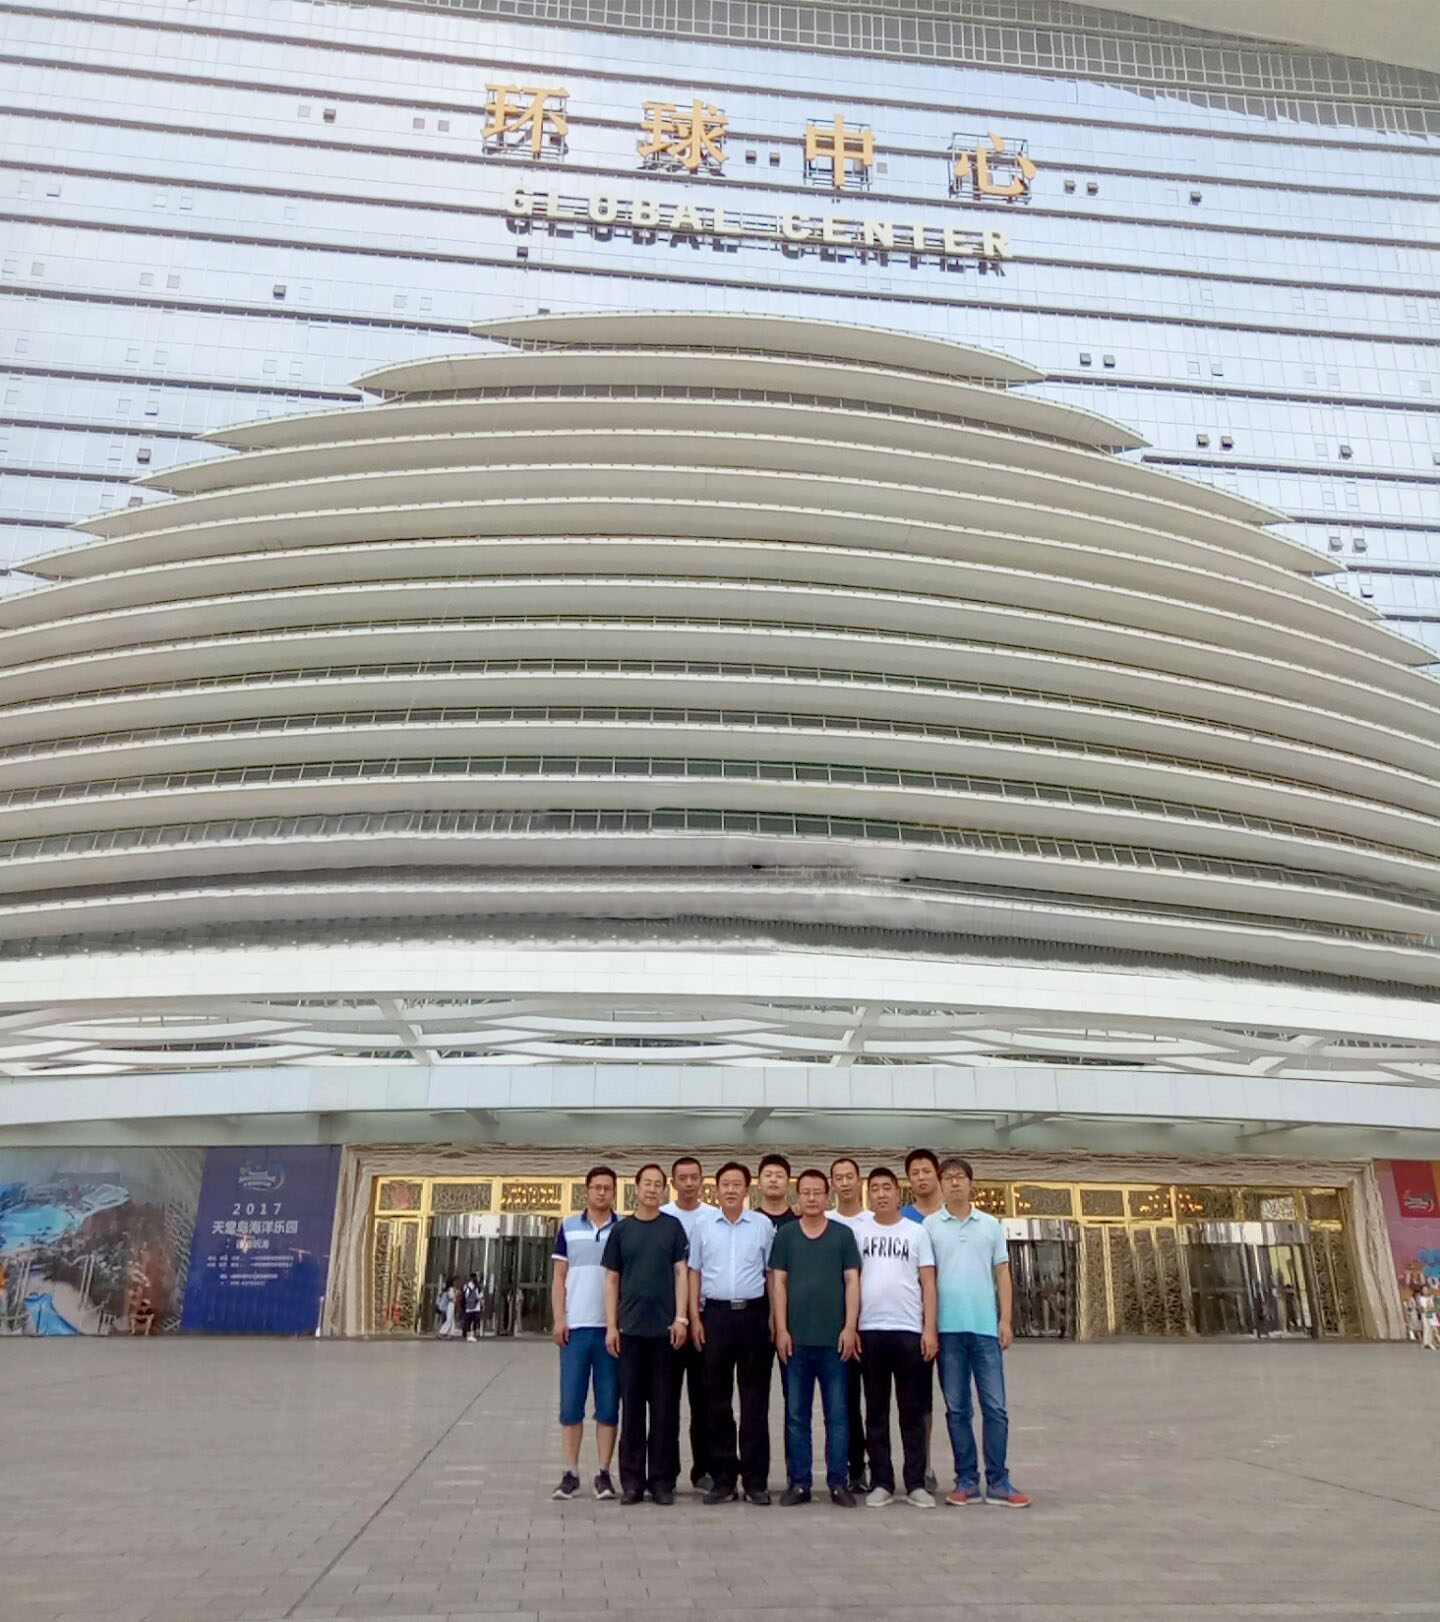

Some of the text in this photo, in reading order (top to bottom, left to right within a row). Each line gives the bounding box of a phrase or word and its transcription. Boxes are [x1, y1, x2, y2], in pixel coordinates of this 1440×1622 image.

[483, 83, 1035, 196] 环球中心
[505, 187, 1012, 258] GLOBAL CENTER
[232, 1203, 281, 1216] 2017
[863, 1236, 909, 1261] AFRICA
